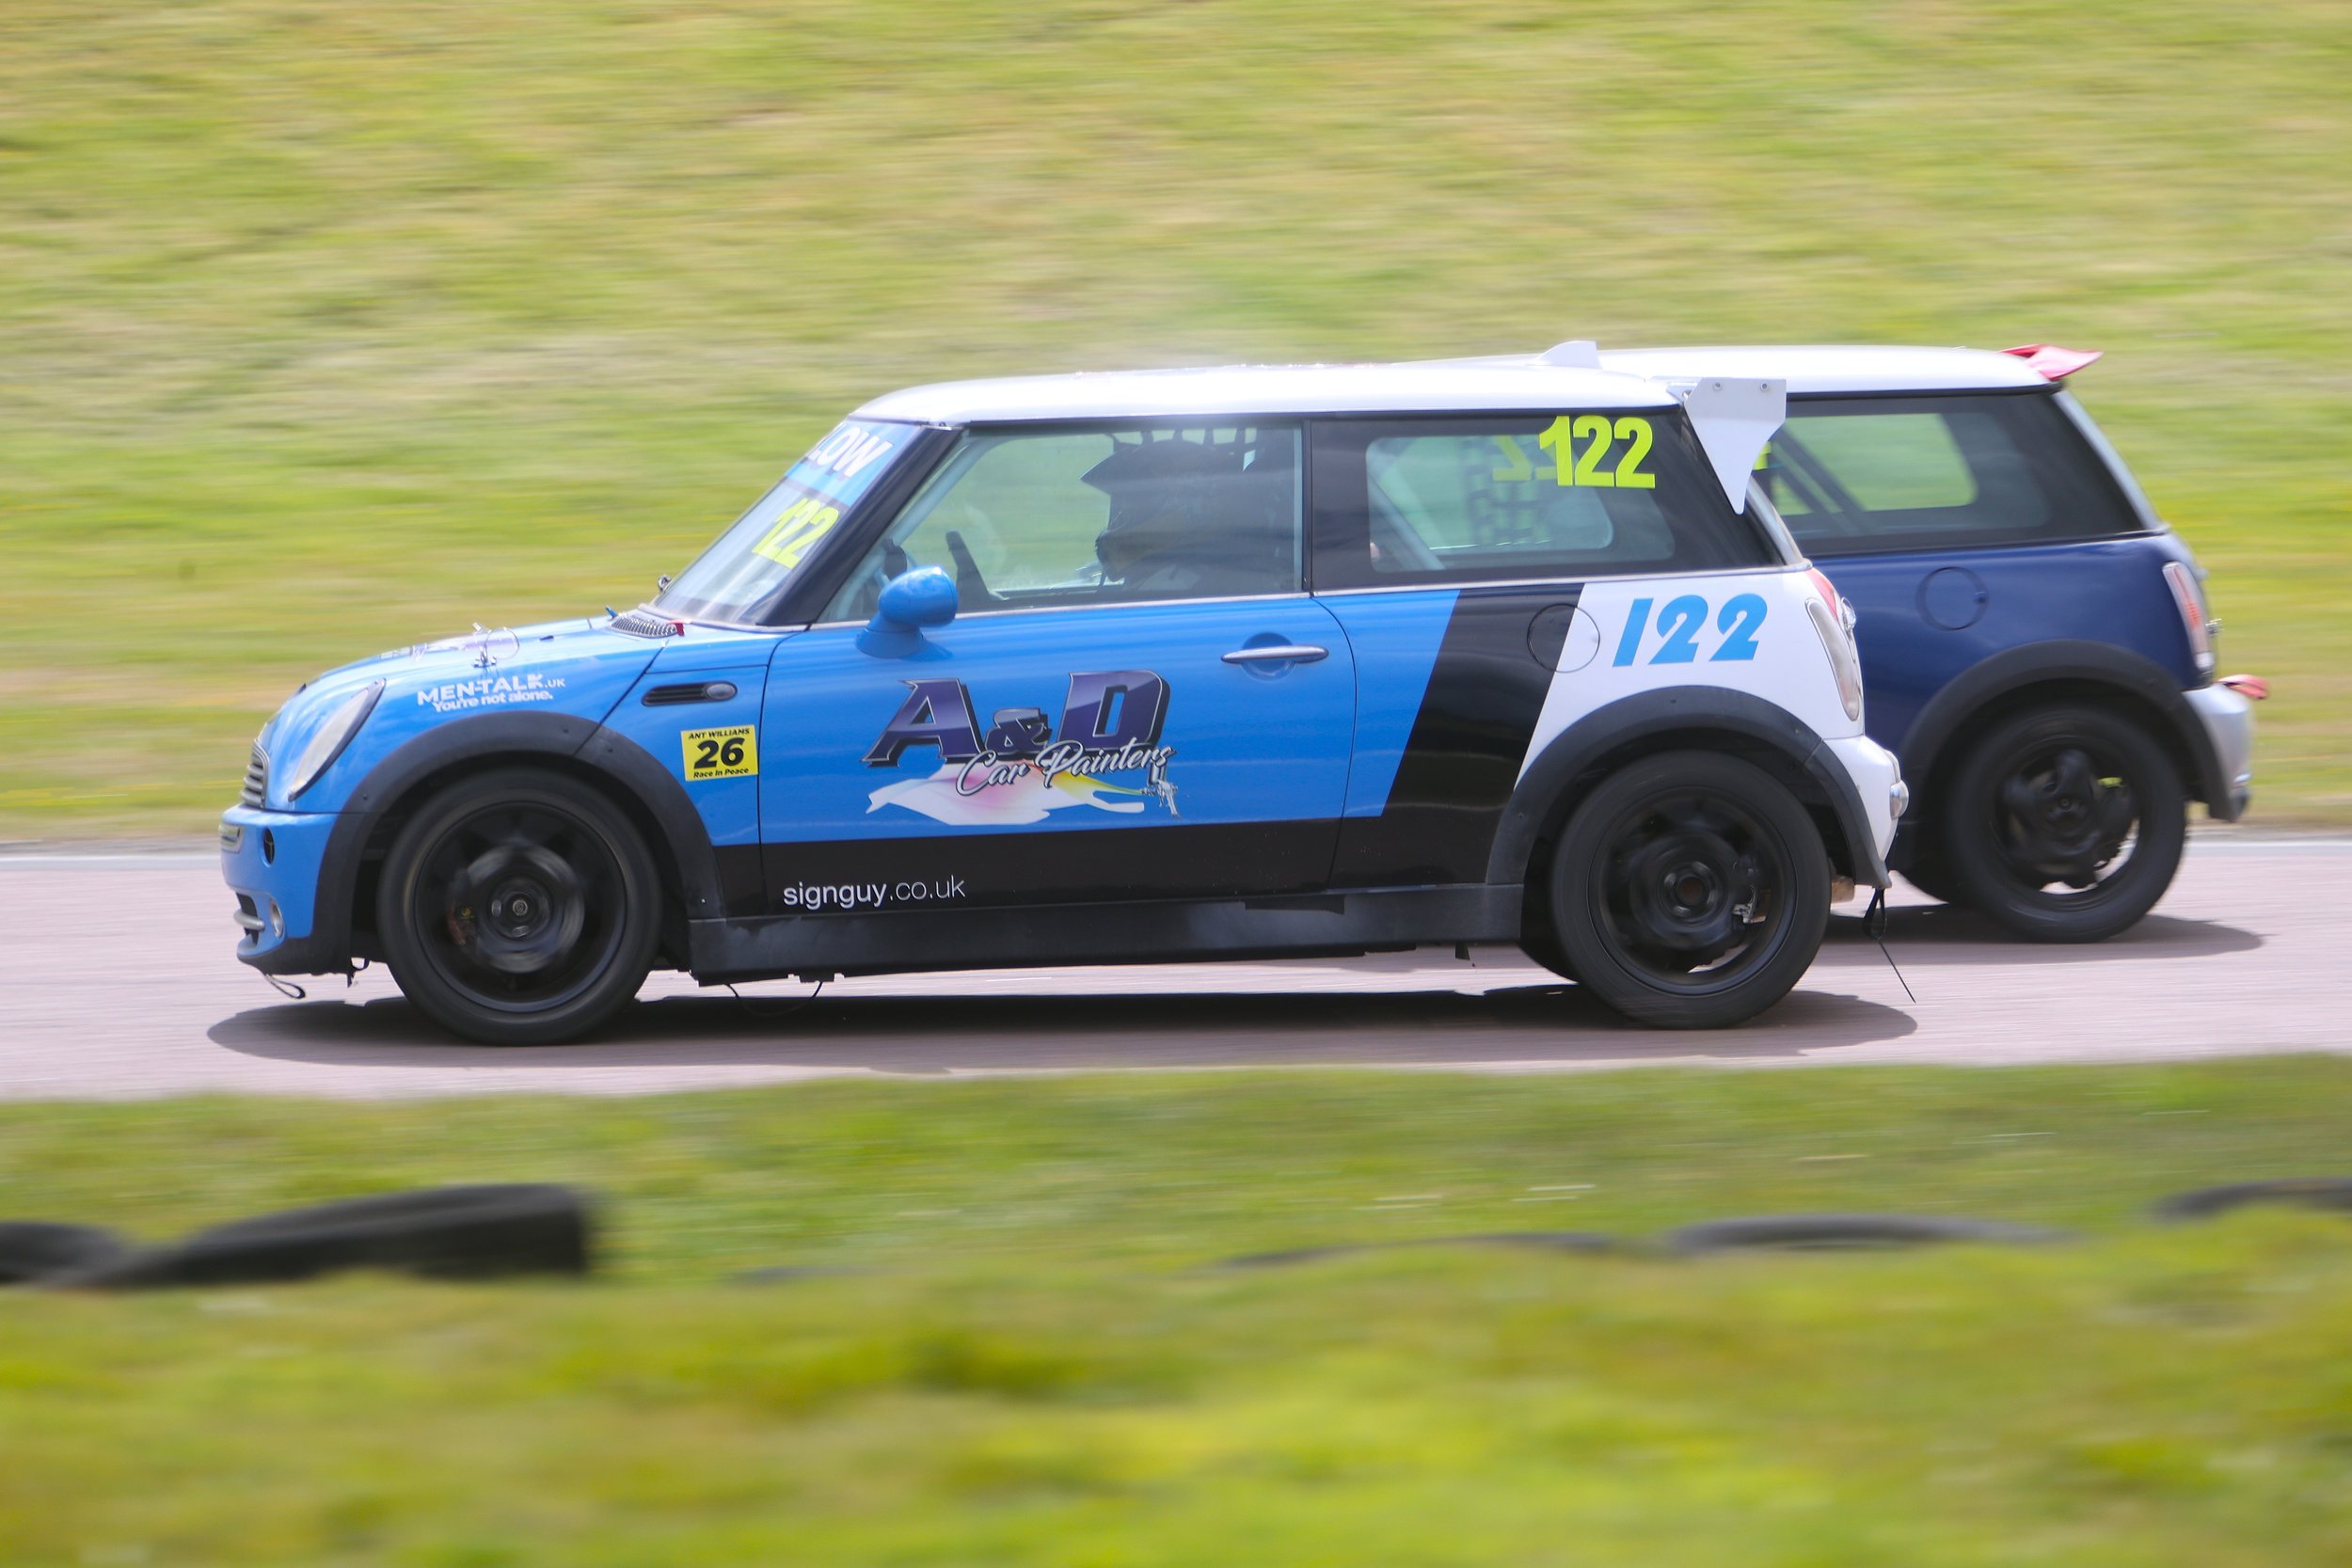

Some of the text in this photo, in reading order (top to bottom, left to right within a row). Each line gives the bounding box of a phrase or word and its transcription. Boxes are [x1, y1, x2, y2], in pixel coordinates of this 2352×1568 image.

[1538, 415, 1656, 489] 122
[752, 498, 839, 570] 122
[1613, 594, 1768, 668] 122
[433, 689, 553, 713] You're not alone.
[859, 669, 1170, 768] A&D
[693, 737, 745, 769] 26
[708, 728, 750, 738] WILLIAMS
[693, 770, 713, 779] Race
[724, 768, 749, 776] Peace
[956, 736, 1174, 797] Car Painters
[783, 875, 966, 911] signguy.co.uk
